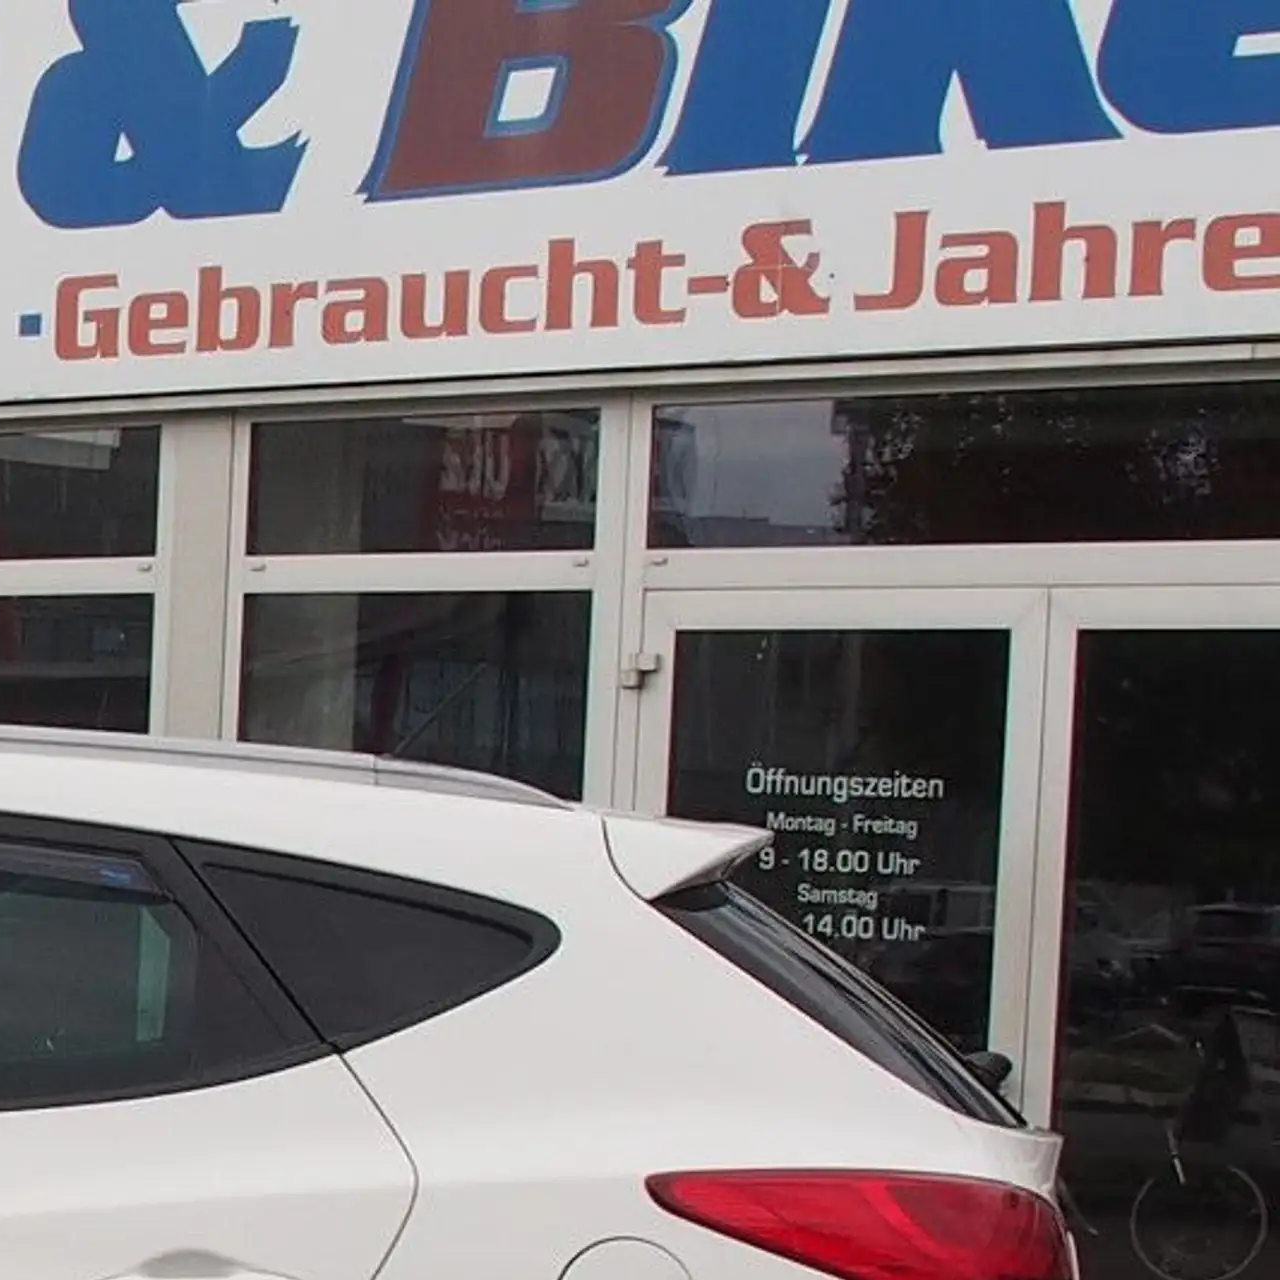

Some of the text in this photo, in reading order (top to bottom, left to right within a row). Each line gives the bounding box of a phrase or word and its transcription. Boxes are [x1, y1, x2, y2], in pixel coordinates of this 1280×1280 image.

[17, 0, 311, 229] &
[746, 761, 944, 802] Öffnungszeiten
[766, 811, 836, 836] Montag
[852, 813, 919, 840] Freitag
[759, 848, 775, 870] 9
[798, 848, 869, 873] 18.00
[877, 850, 921, 875] Uhr
[797, 883, 878, 911] Samstag
[803, 913, 926, 942] 14.00 Uhr
